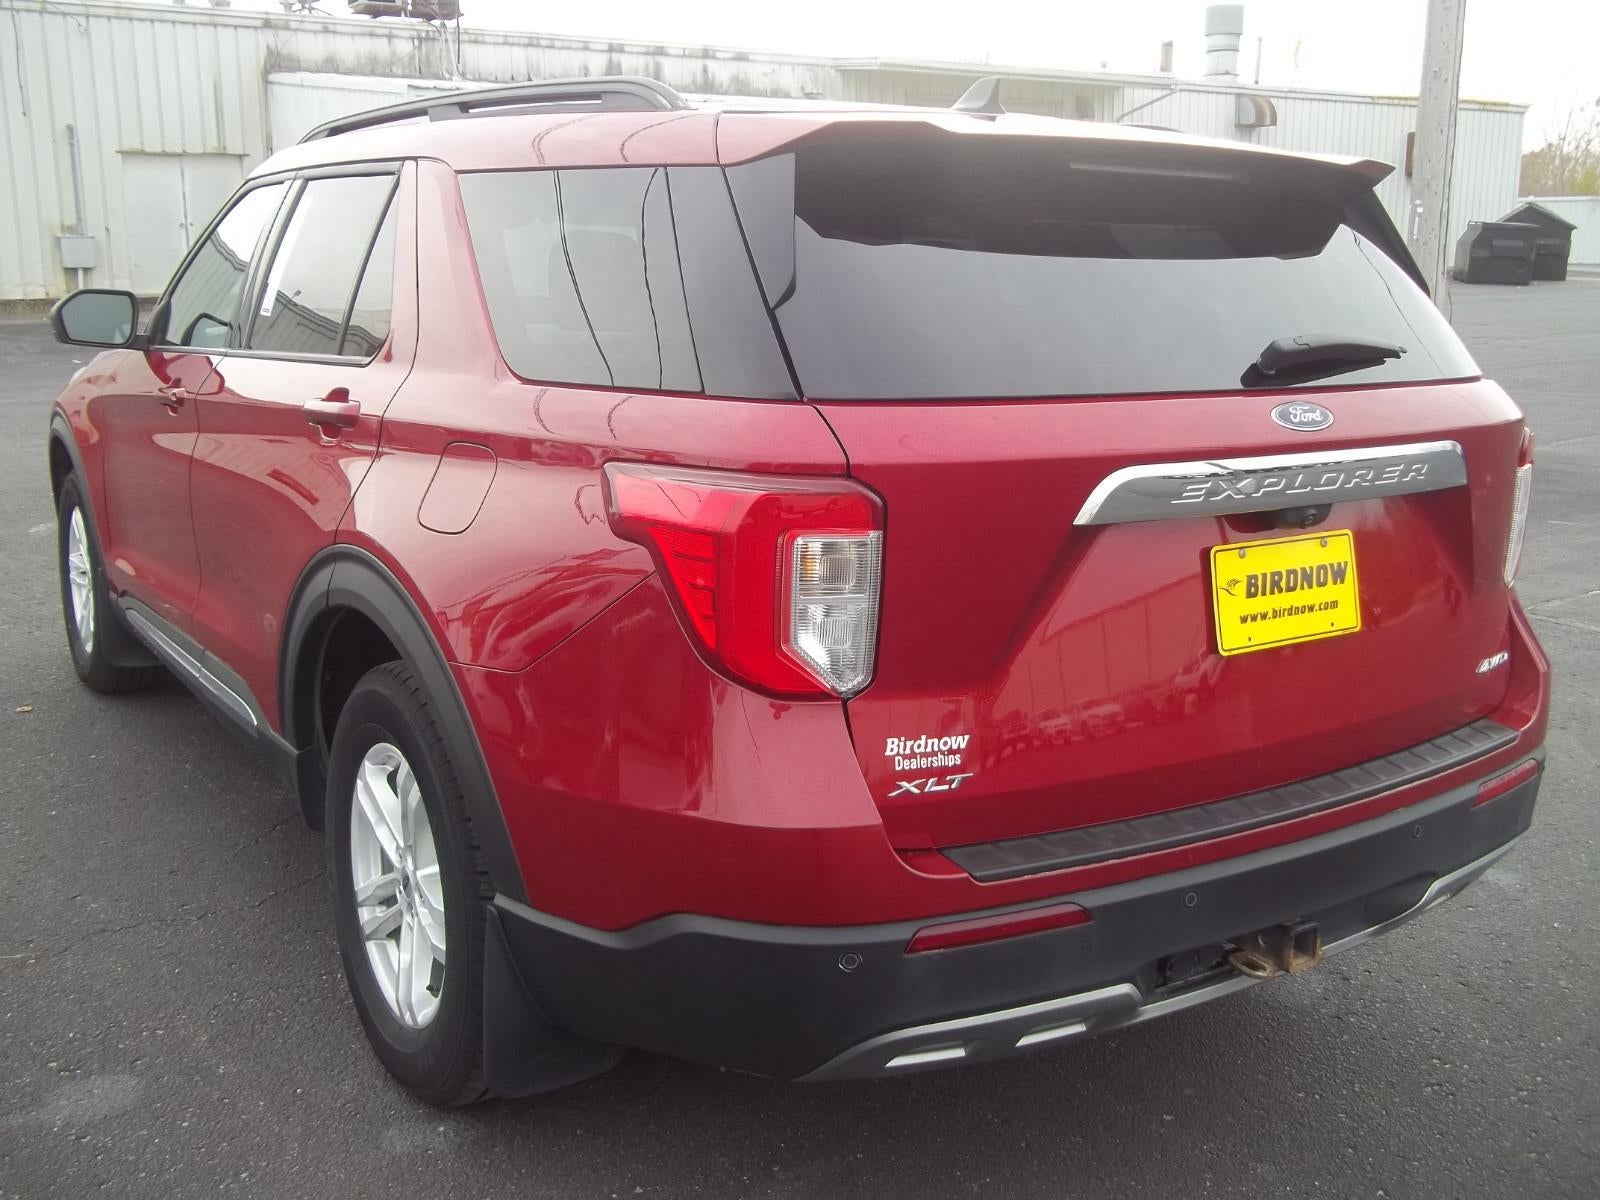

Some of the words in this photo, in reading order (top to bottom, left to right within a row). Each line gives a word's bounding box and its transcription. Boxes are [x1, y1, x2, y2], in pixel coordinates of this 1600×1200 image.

[1289, 406, 1323, 423] Ford
[1172, 463, 1428, 504] EXPLORER
[1246, 561, 1348, 599] BIRDNOW
[1240, 600, 1339, 624] www.birdnow.com
[885, 735, 970, 755] Birdnow
[895, 752, 961, 771] Dealerships
[887, 773, 973, 796] XLT
